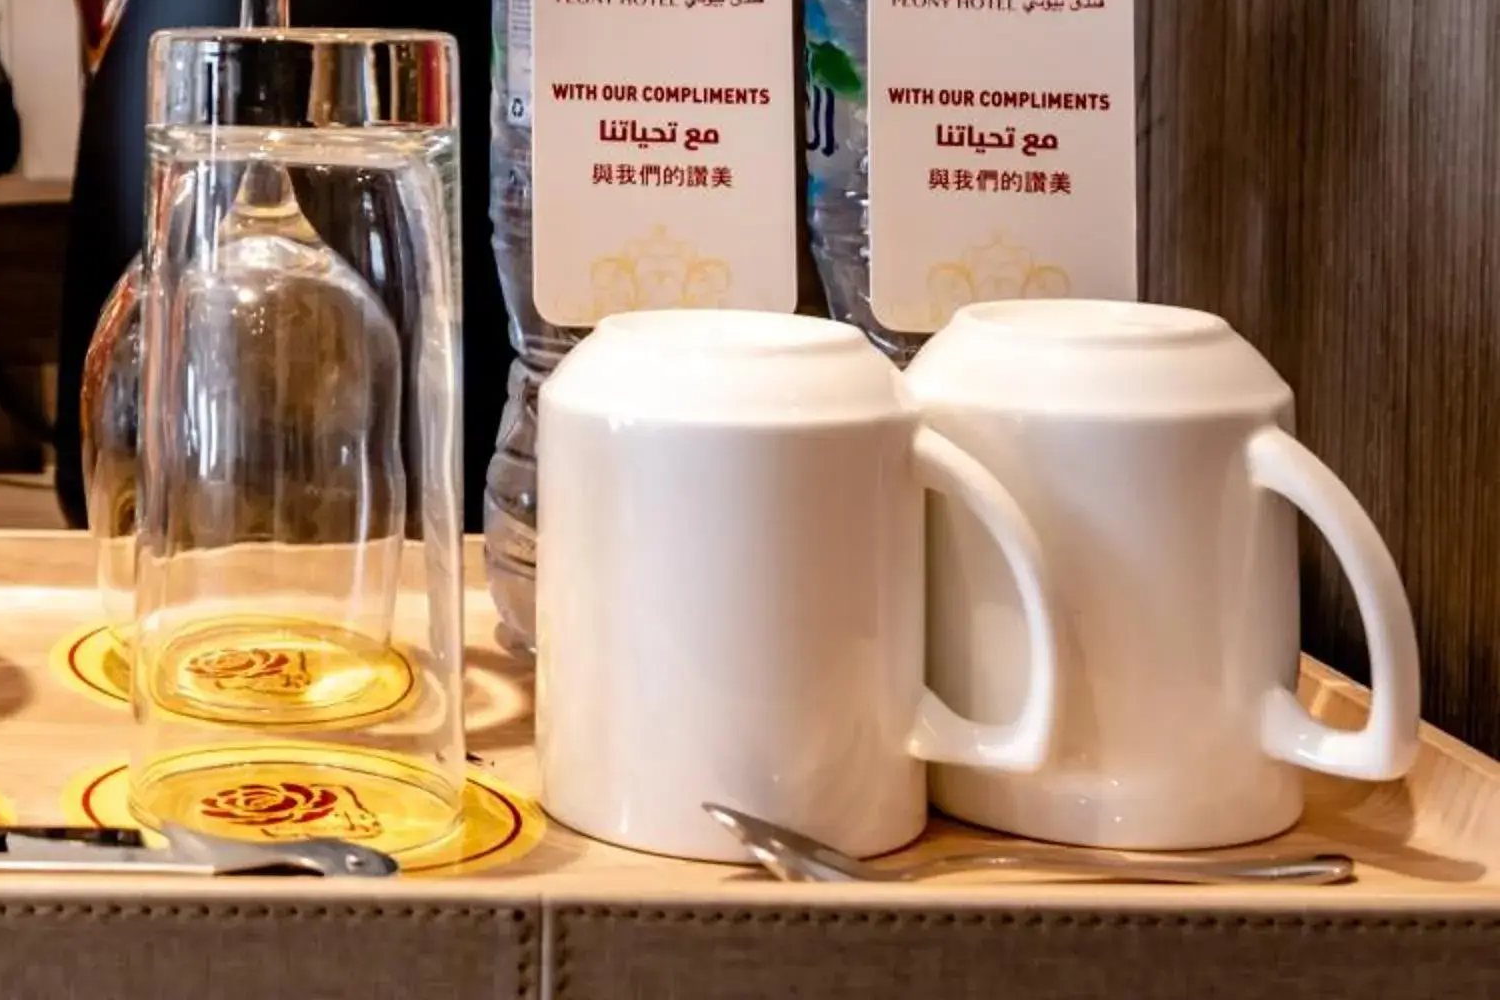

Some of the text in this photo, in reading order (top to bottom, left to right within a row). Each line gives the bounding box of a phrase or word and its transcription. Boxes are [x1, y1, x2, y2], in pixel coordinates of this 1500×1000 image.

[551, 83, 772, 105] WITH OUR COMPLIMENTS
[888, 87, 1111, 111] WITH OUR COMPLIMENTS
[599, 119, 720, 151] مع تحياتنا
[936, 123, 1059, 156] مع تحياتنا
[591, 162, 734, 188] 與我們的讚美
[928, 168, 1072, 194] 與我們的讚美
